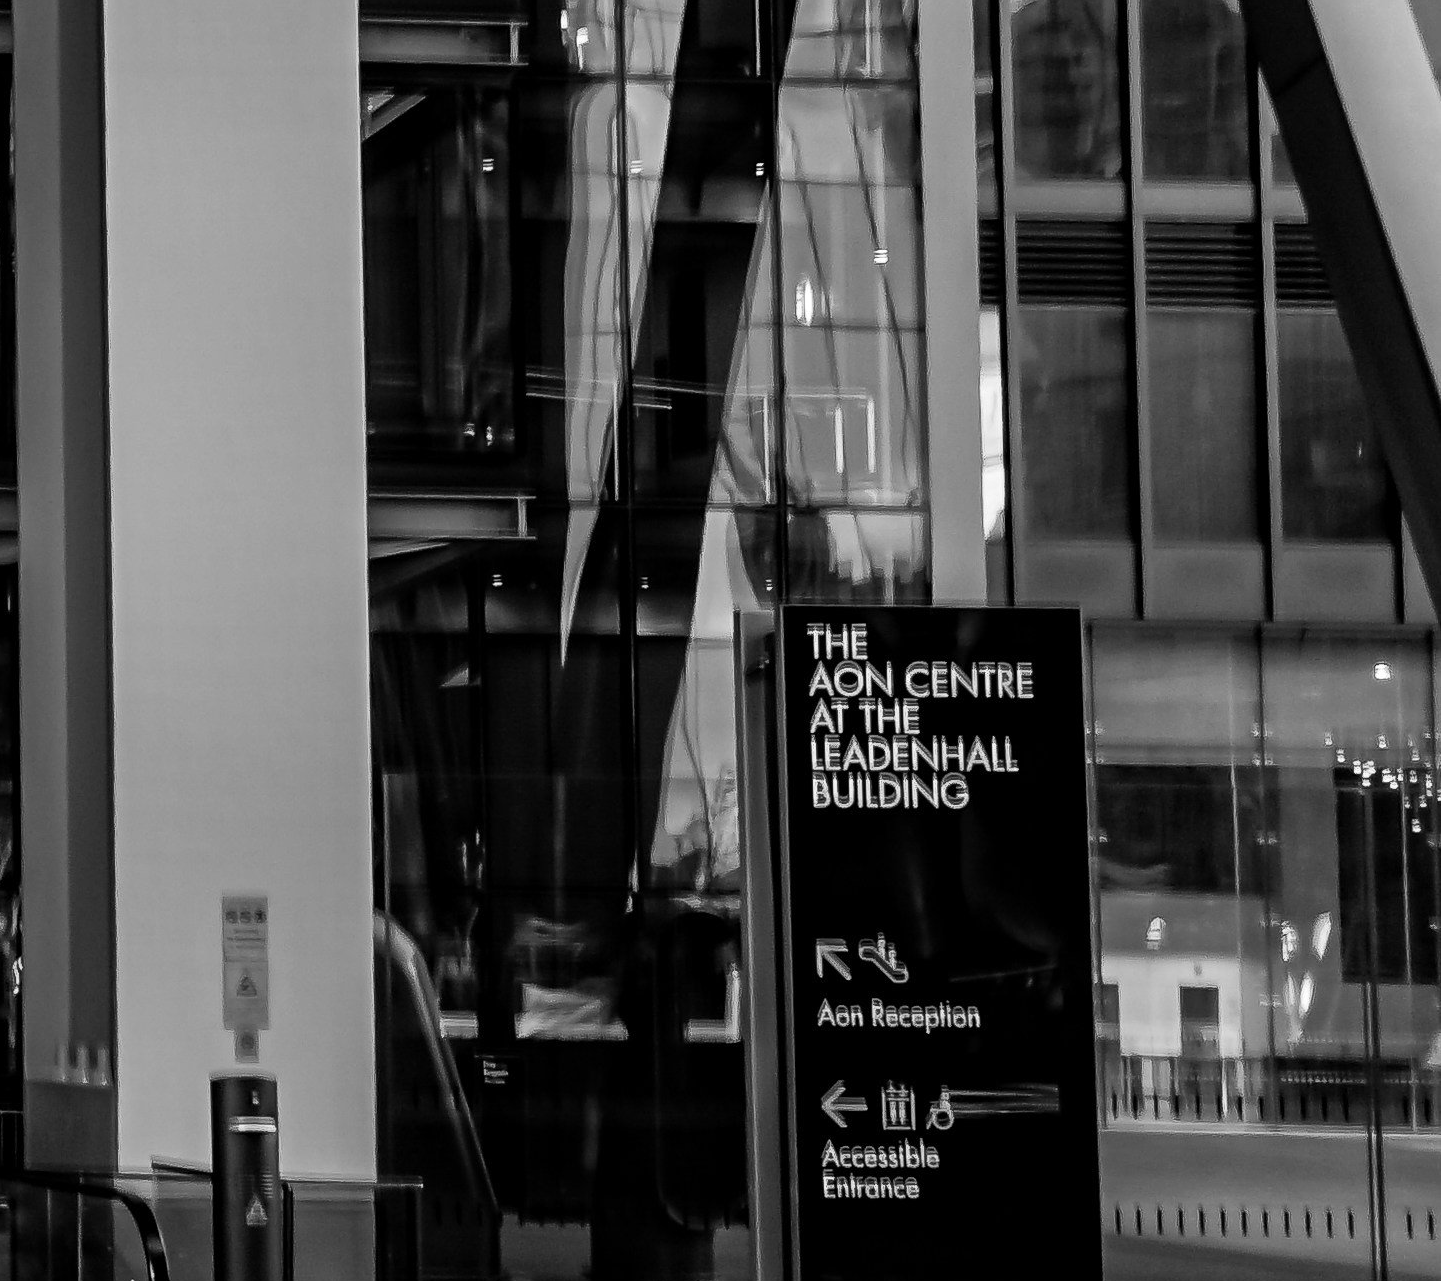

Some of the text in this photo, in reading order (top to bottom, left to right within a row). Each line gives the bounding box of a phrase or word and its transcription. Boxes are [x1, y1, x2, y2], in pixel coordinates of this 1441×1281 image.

[807, 623, 868, 660] THE
[809, 661, 1035, 700] AON CENTRE
[809, 697, 921, 735] AT THE
[810, 734, 1020, 773] LEADENHALL
[812, 772, 971, 810] BUILDING
[817, 998, 981, 1035] Aon Reception
[821, 1138, 941, 1170] Accessible
[823, 1169, 921, 1200] Entrance
